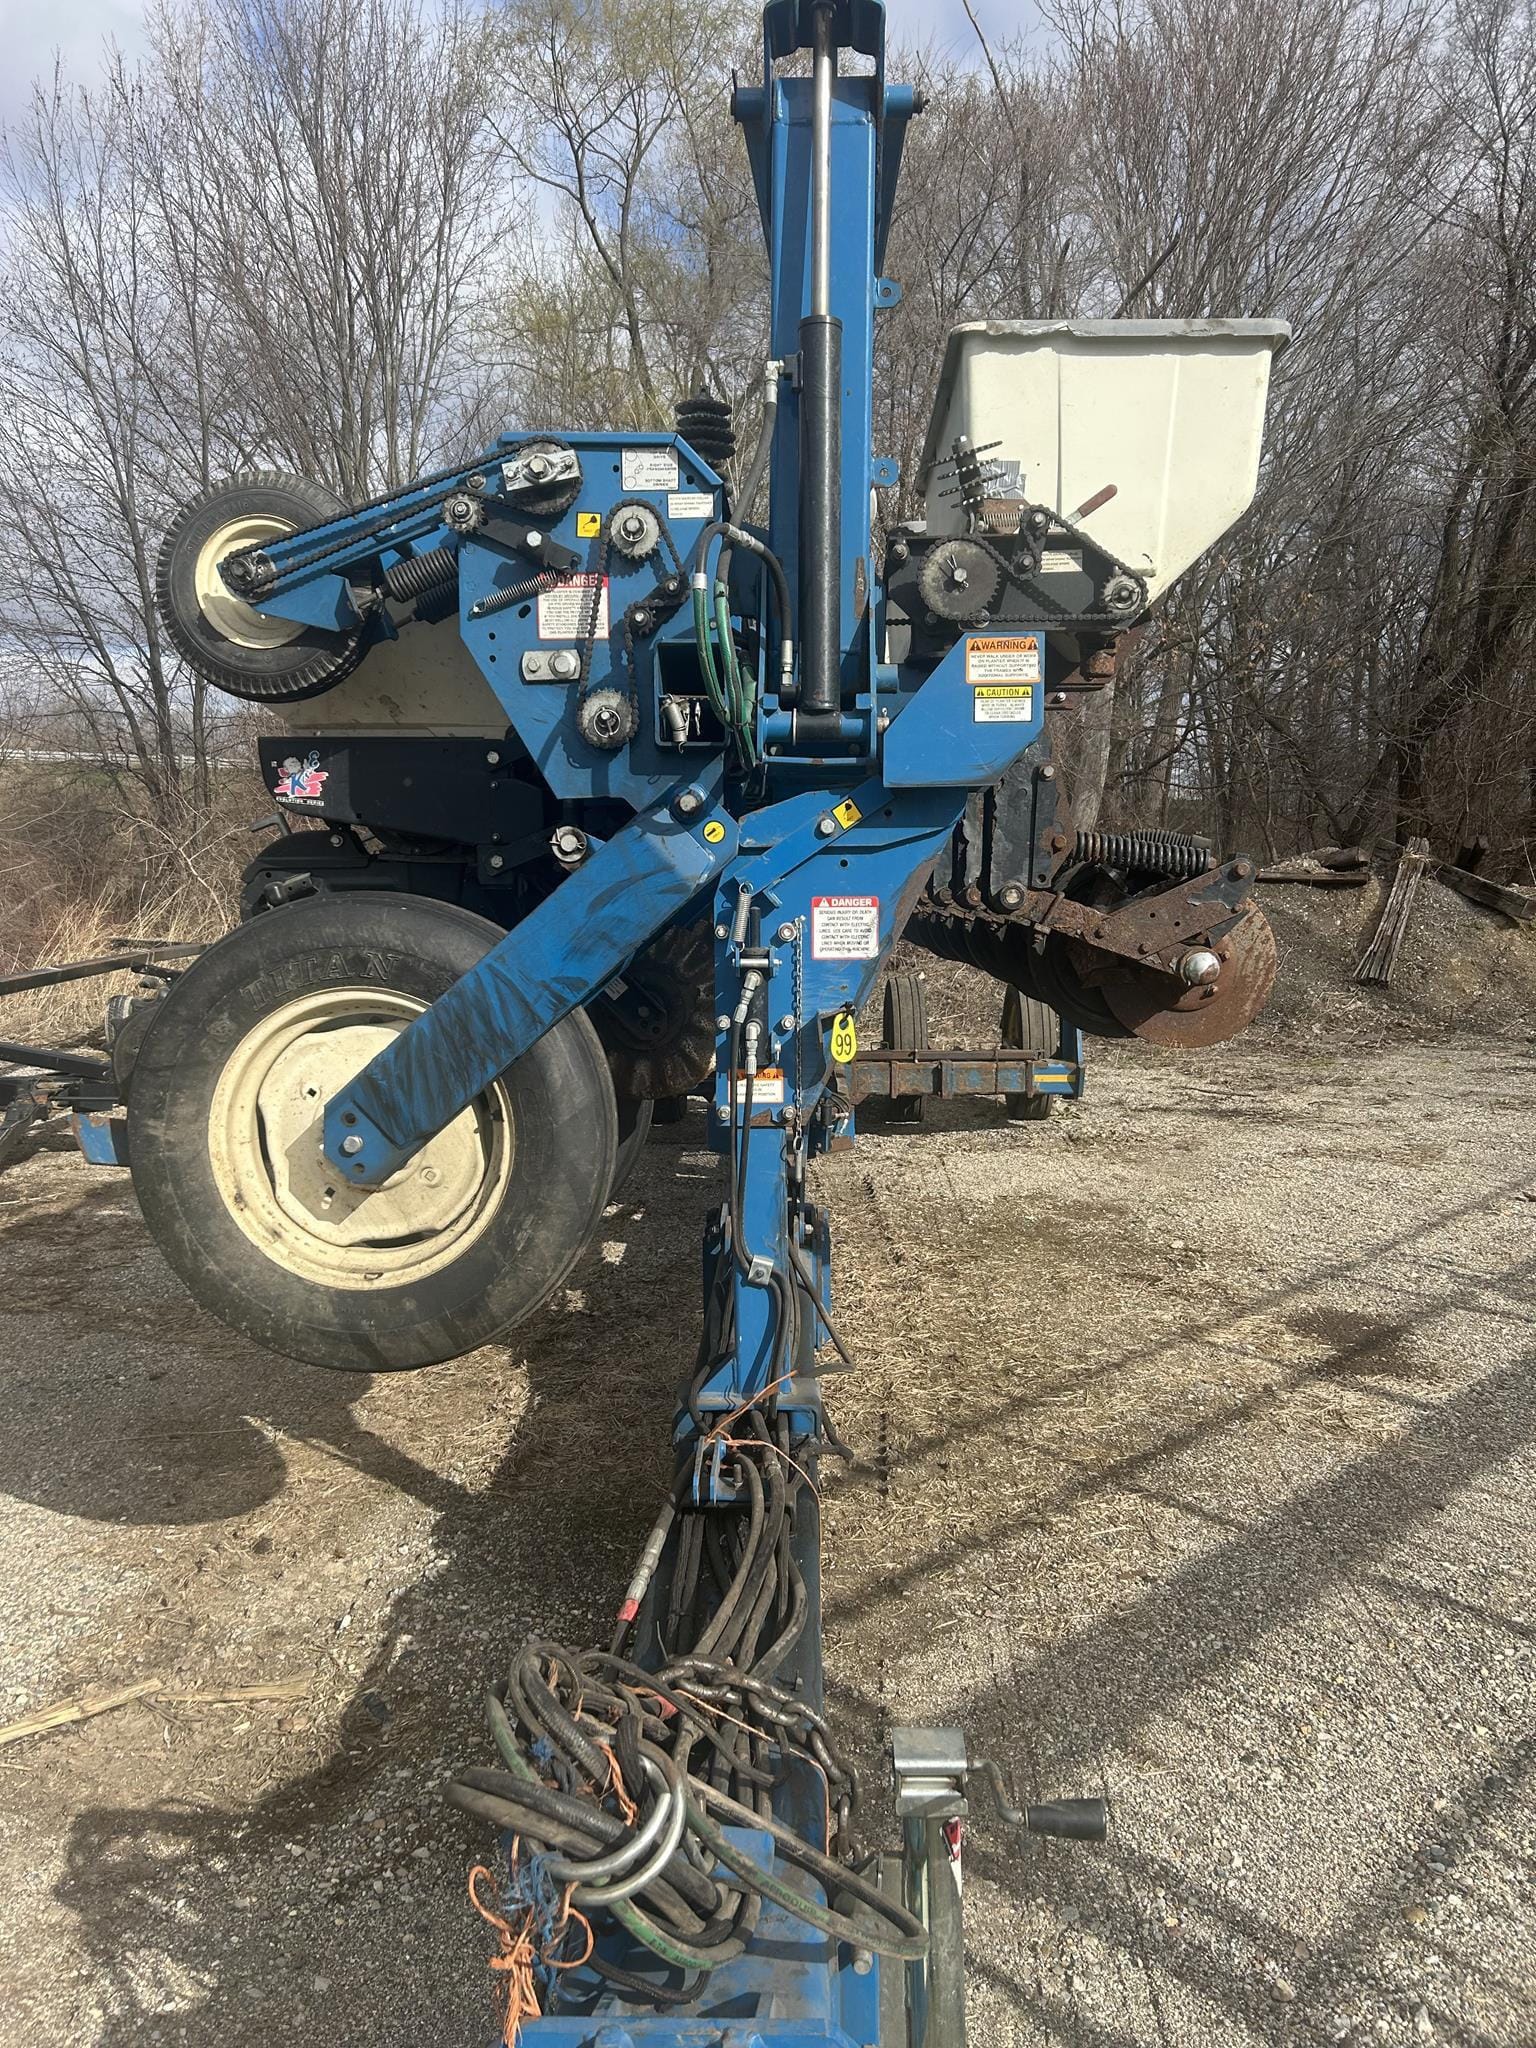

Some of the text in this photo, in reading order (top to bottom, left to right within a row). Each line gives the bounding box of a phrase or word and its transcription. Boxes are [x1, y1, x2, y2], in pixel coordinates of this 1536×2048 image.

[557, 574, 603, 587] DANGE
[981, 640, 1026, 650] WARNING
[831, 899, 873, 907] DANGER
[240, 951, 401, 1011] TITAN
[836, 1034, 852, 1056] 99
